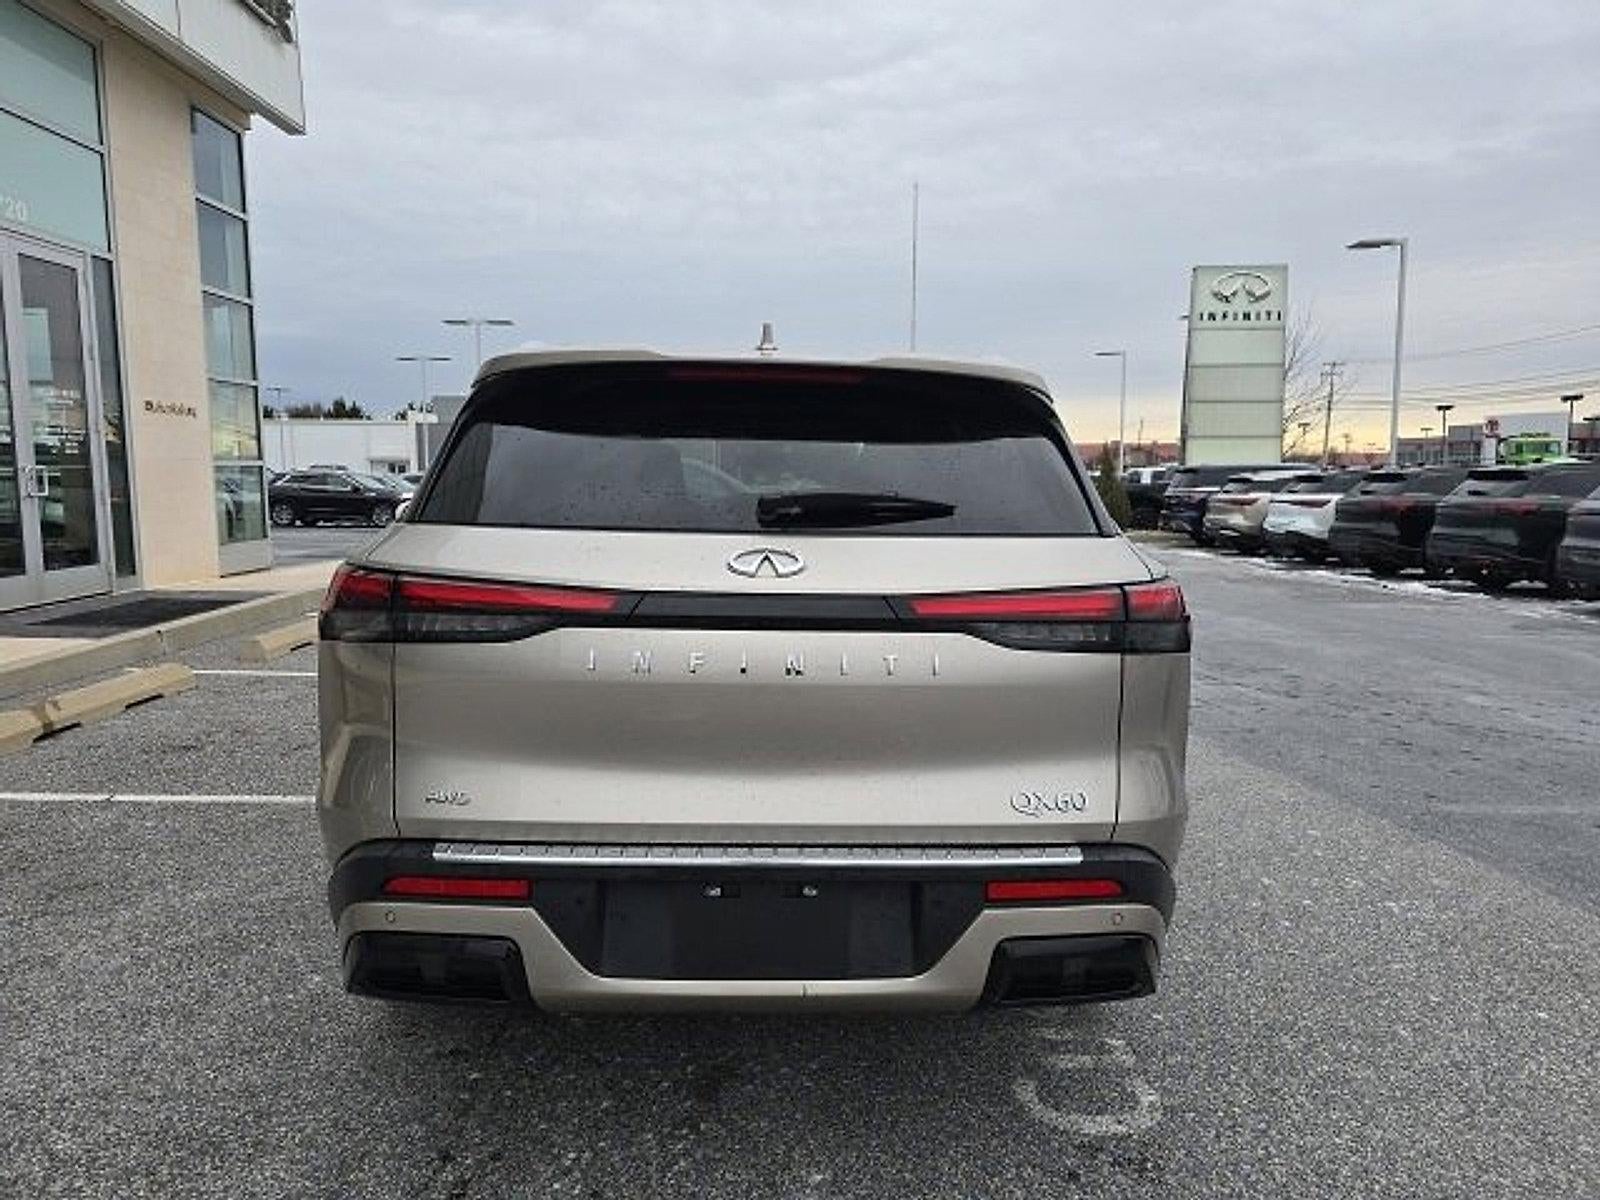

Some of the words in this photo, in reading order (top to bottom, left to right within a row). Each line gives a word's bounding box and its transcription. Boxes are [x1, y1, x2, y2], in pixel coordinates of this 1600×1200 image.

[1199, 310, 1282, 321] INFINITI
[586, 647, 941, 677] INFINITI
[1009, 791, 1088, 818] QX60
